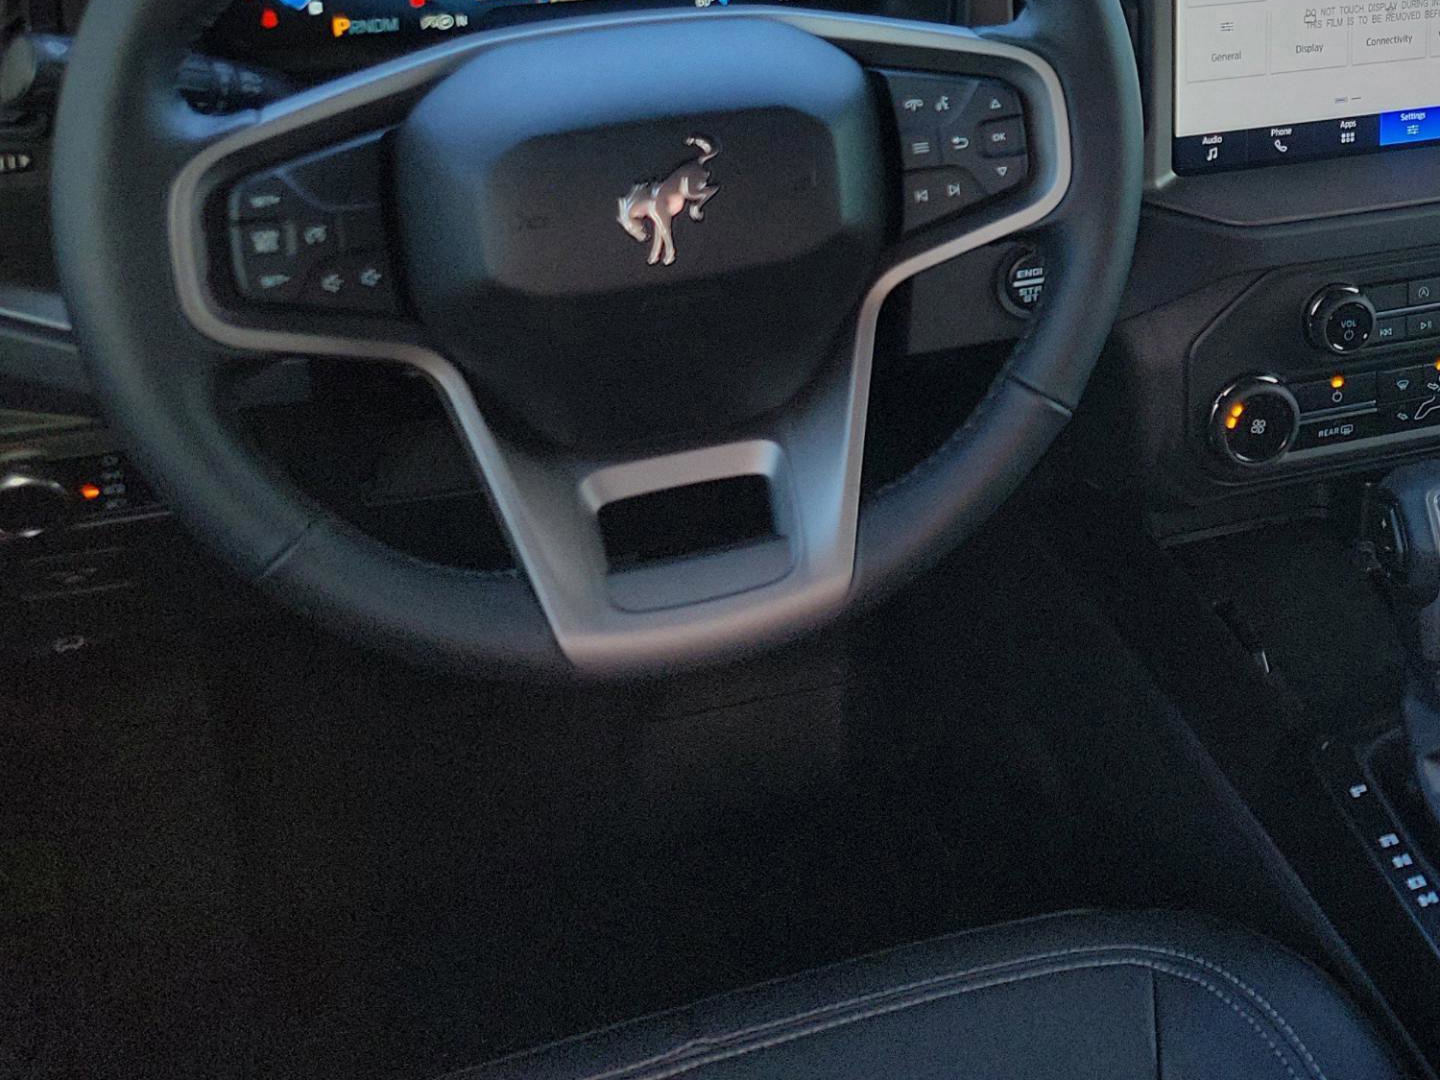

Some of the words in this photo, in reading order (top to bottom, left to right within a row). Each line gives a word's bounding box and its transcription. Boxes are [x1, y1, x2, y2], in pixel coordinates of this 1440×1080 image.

[1340, 4, 1365, 15] TOUCH
[1368, 1, 1398, 13] DISPLAY
[1366, 33, 1414, 47] Connectivity
[1295, 42, 1324, 55] Display
[1211, 50, 1242, 64] General
[1400, 110, 1426, 123] Settings
[1339, 119, 1357, 131] Apps
[991, 131, 1007, 143] OK
[1270, 126, 1292, 138] Phone
[1202, 134, 1223, 146] Audio
[1341, 320, 1357, 329] VOL
[1318, 426, 1340, 439] REAR
